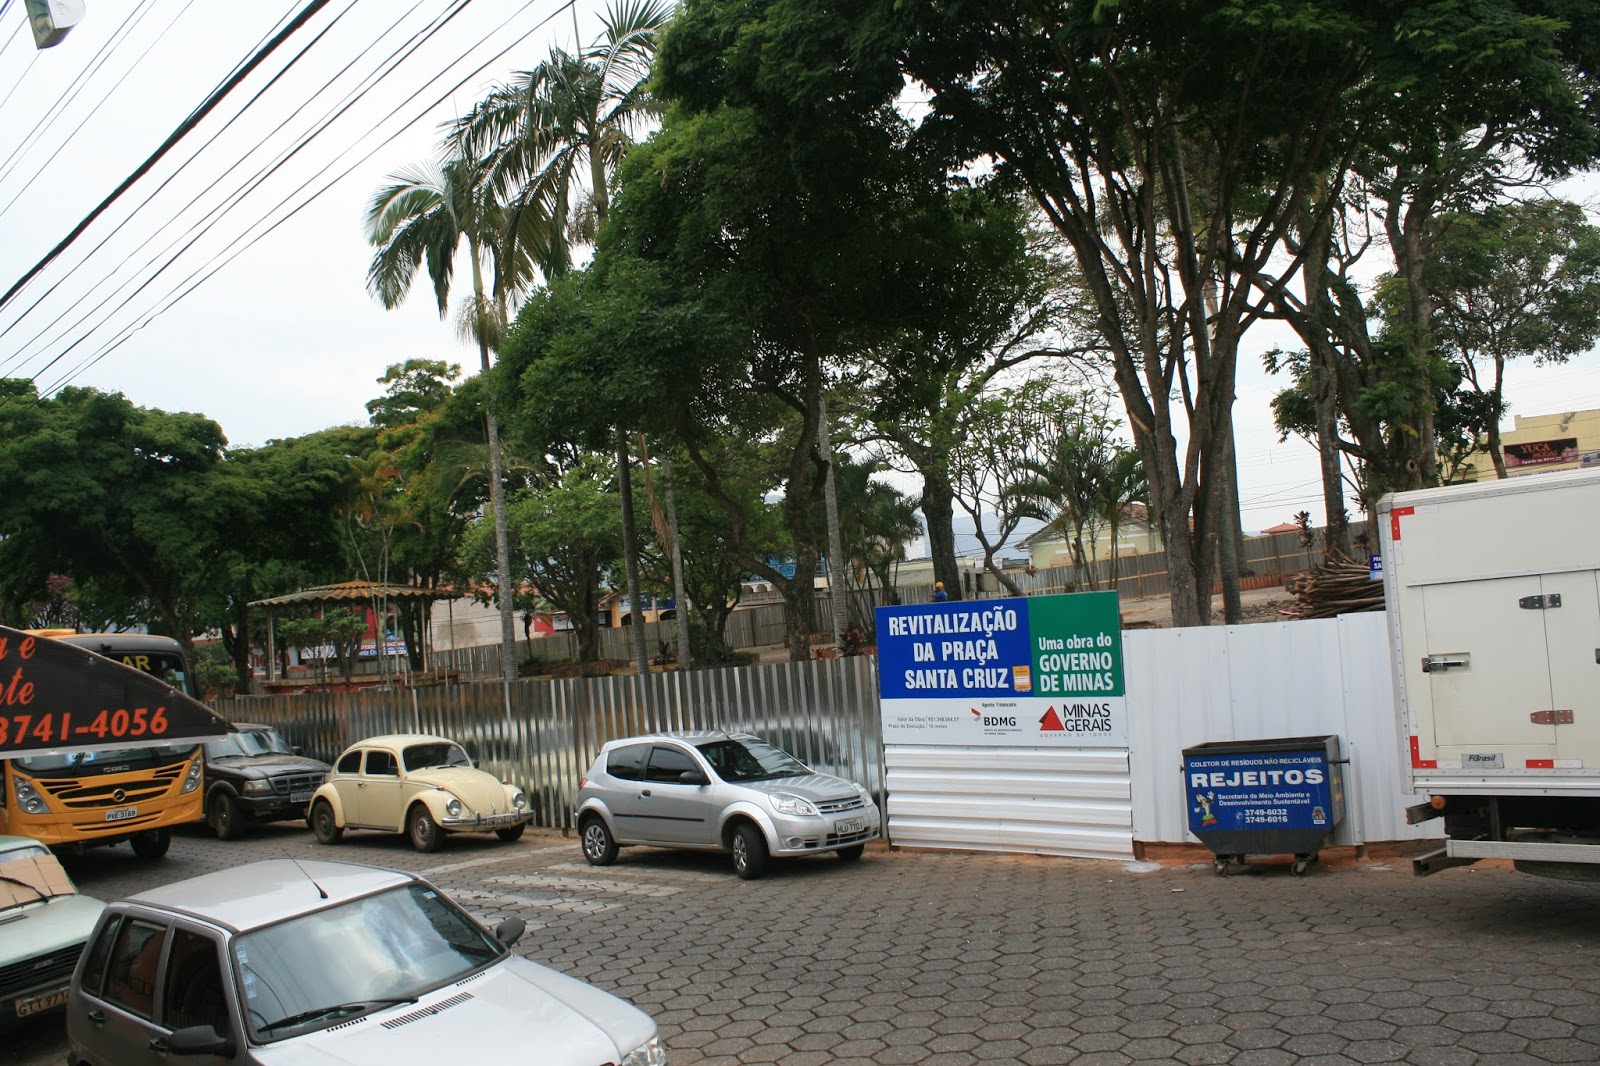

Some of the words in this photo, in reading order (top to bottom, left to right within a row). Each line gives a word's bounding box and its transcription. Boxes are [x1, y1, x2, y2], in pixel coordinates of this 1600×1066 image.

[1521, 443, 1550, 453] YUCA
[888, 605, 1017, 637] REVITALIZAÇÃO
[18, 636, 35, 659] e
[1038, 636, 1064, 650] Uma
[1066, 634, 1093, 649] obra
[1096, 632, 1112, 647] do
[913, 642, 935, 662] DA
[941, 639, 999, 666] PRAÇA
[1039, 652, 1112, 672] GOVERNO
[904, 669, 958, 689] SANTA
[962, 668, 1009, 689] CRUZ
[1040, 674, 1060, 692] DE
[1063, 672, 1114, 691] MINAS
[1063, 703, 1111, 718] MINAS
[984, 716, 1016, 726] BDMG
[1065, 719, 1112, 731] GERAIS
[1279, 756, 1322, 764] RECICLÁVEIS
[1191, 769, 1324, 787] REJEITOS
[1244, 808, 1287, 816] 3749-6032
